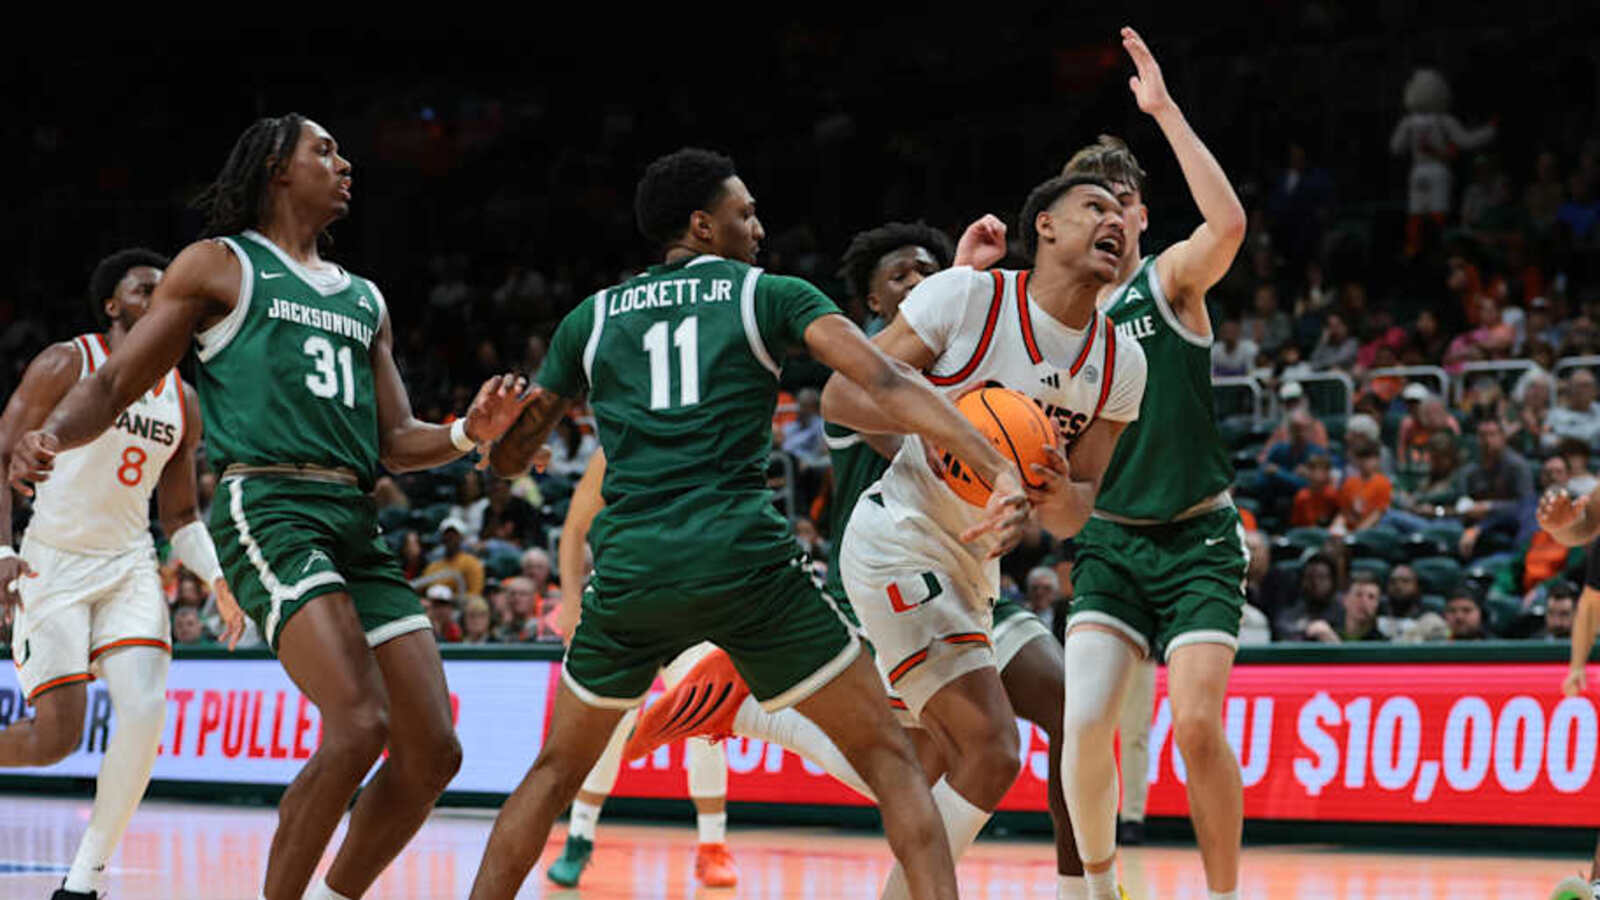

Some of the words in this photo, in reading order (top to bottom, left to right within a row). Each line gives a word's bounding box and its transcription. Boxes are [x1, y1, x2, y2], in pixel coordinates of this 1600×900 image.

[608, 278, 701, 317] LOCKETT
[702, 278, 733, 302] JR
[303, 335, 355, 409] 31
[643, 315, 699, 411] 11
[115, 411, 177, 446] ANES
[117, 445, 147, 487] 8
[196, 689, 323, 760] PULLE
[1293, 691, 1598, 803] $10,000
